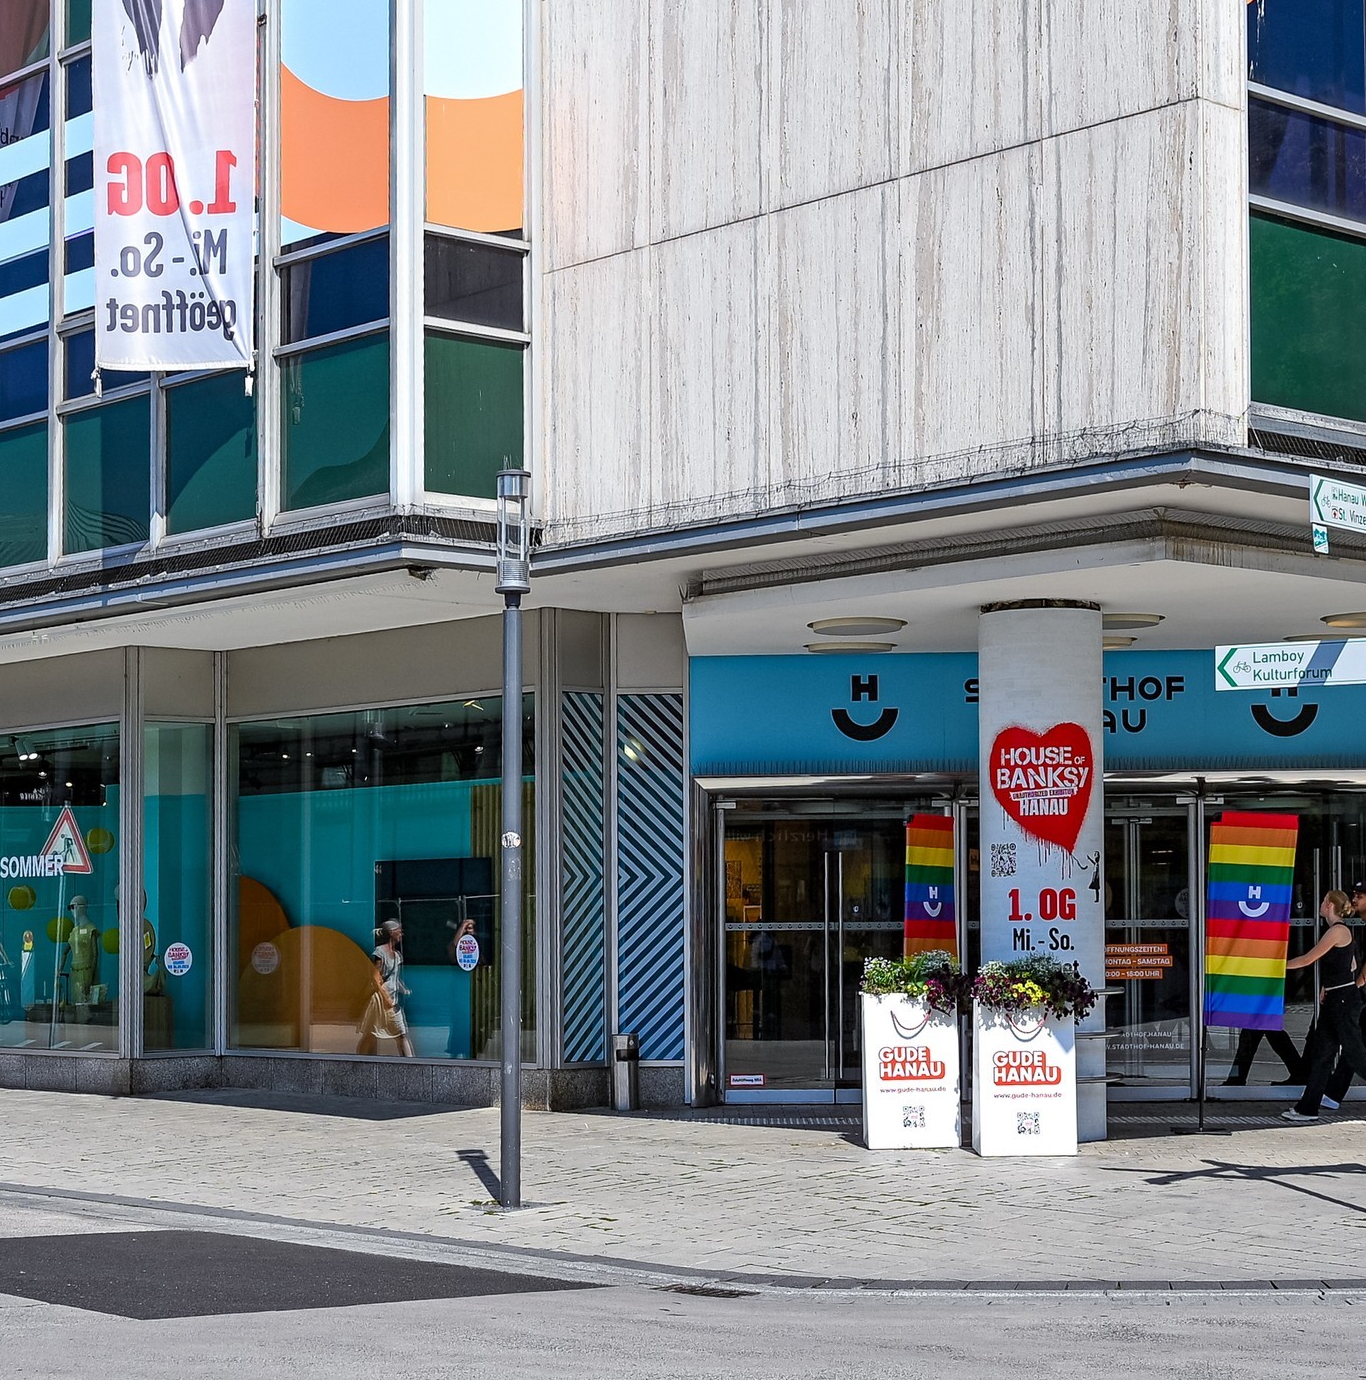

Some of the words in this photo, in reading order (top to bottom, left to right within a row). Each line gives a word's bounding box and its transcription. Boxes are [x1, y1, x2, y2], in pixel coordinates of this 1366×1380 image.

[1338, 489, 1359, 505] Hanau
[1252, 650, 1305, 665] Lamboy
[1252, 667, 1333, 682] Kulturforum
[851, 674, 879, 702] H
[1000, 746, 1073, 766] HOUSE
[1074, 756, 1086, 765] OF
[996, 766, 1090, 790] BANKSY
[1019, 798, 1069, 816] HANAU
[0, 854, 64, 879] SOMMER
[1039, 887, 1077, 921] OG
[879, 1047, 929, 1062] GUDE
[993, 1051, 1045, 1067] GUDE
[880, 1061, 944, 1079] HANAU
[993, 1066, 1060, 1085] HANAU
[880, 1086, 947, 1094] www.gude-hanau.de
